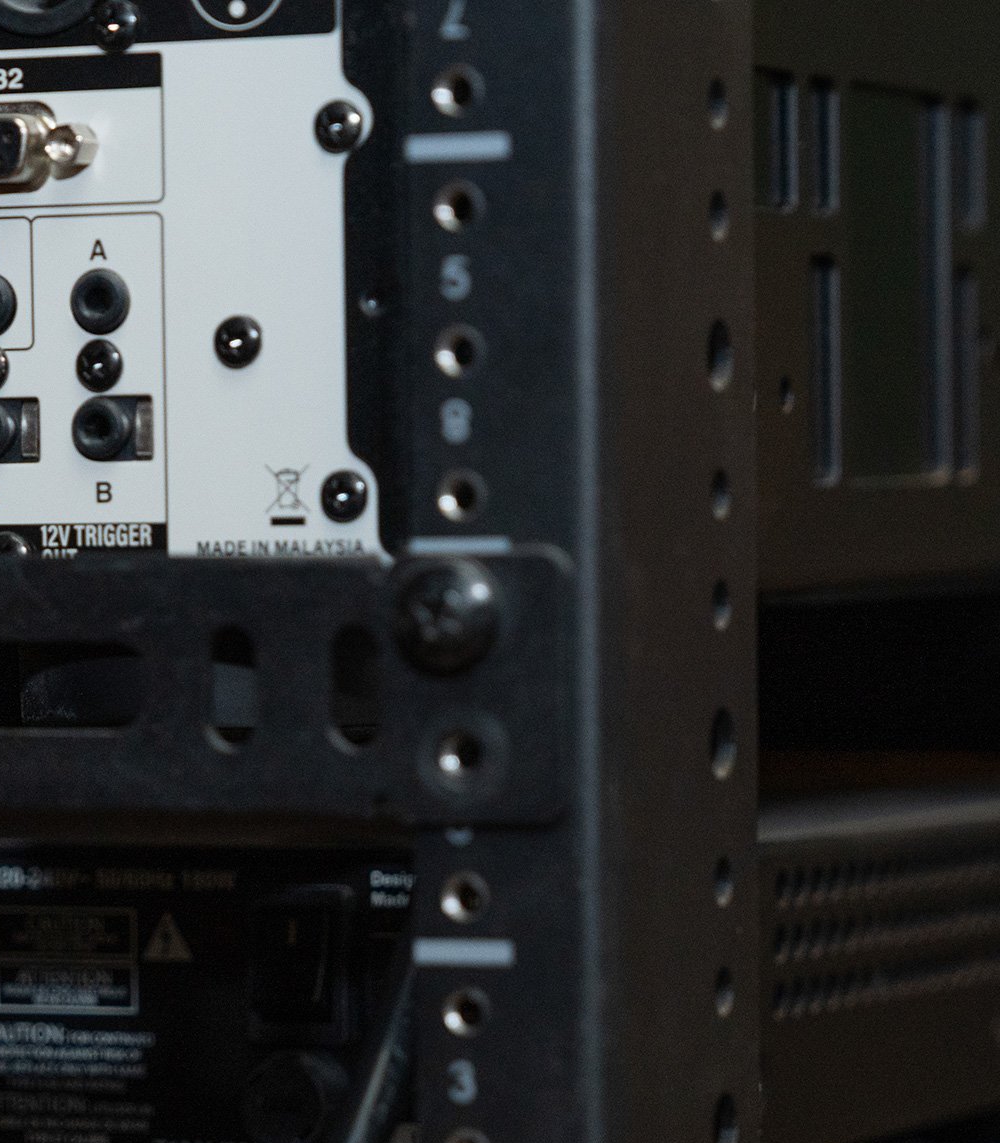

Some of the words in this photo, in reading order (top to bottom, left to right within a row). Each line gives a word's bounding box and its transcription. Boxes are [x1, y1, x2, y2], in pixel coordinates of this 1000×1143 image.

[89, 239, 108, 261] A
[95, 482, 113, 504] B
[40, 525, 71, 547] 12V
[74, 523, 152, 547] TRIGGER
[197, 540, 247, 557] MADE
[251, 540, 269, 556] IN
[274, 539, 364, 556] MALAYSIA
[449, 1060, 478, 1104] 3
